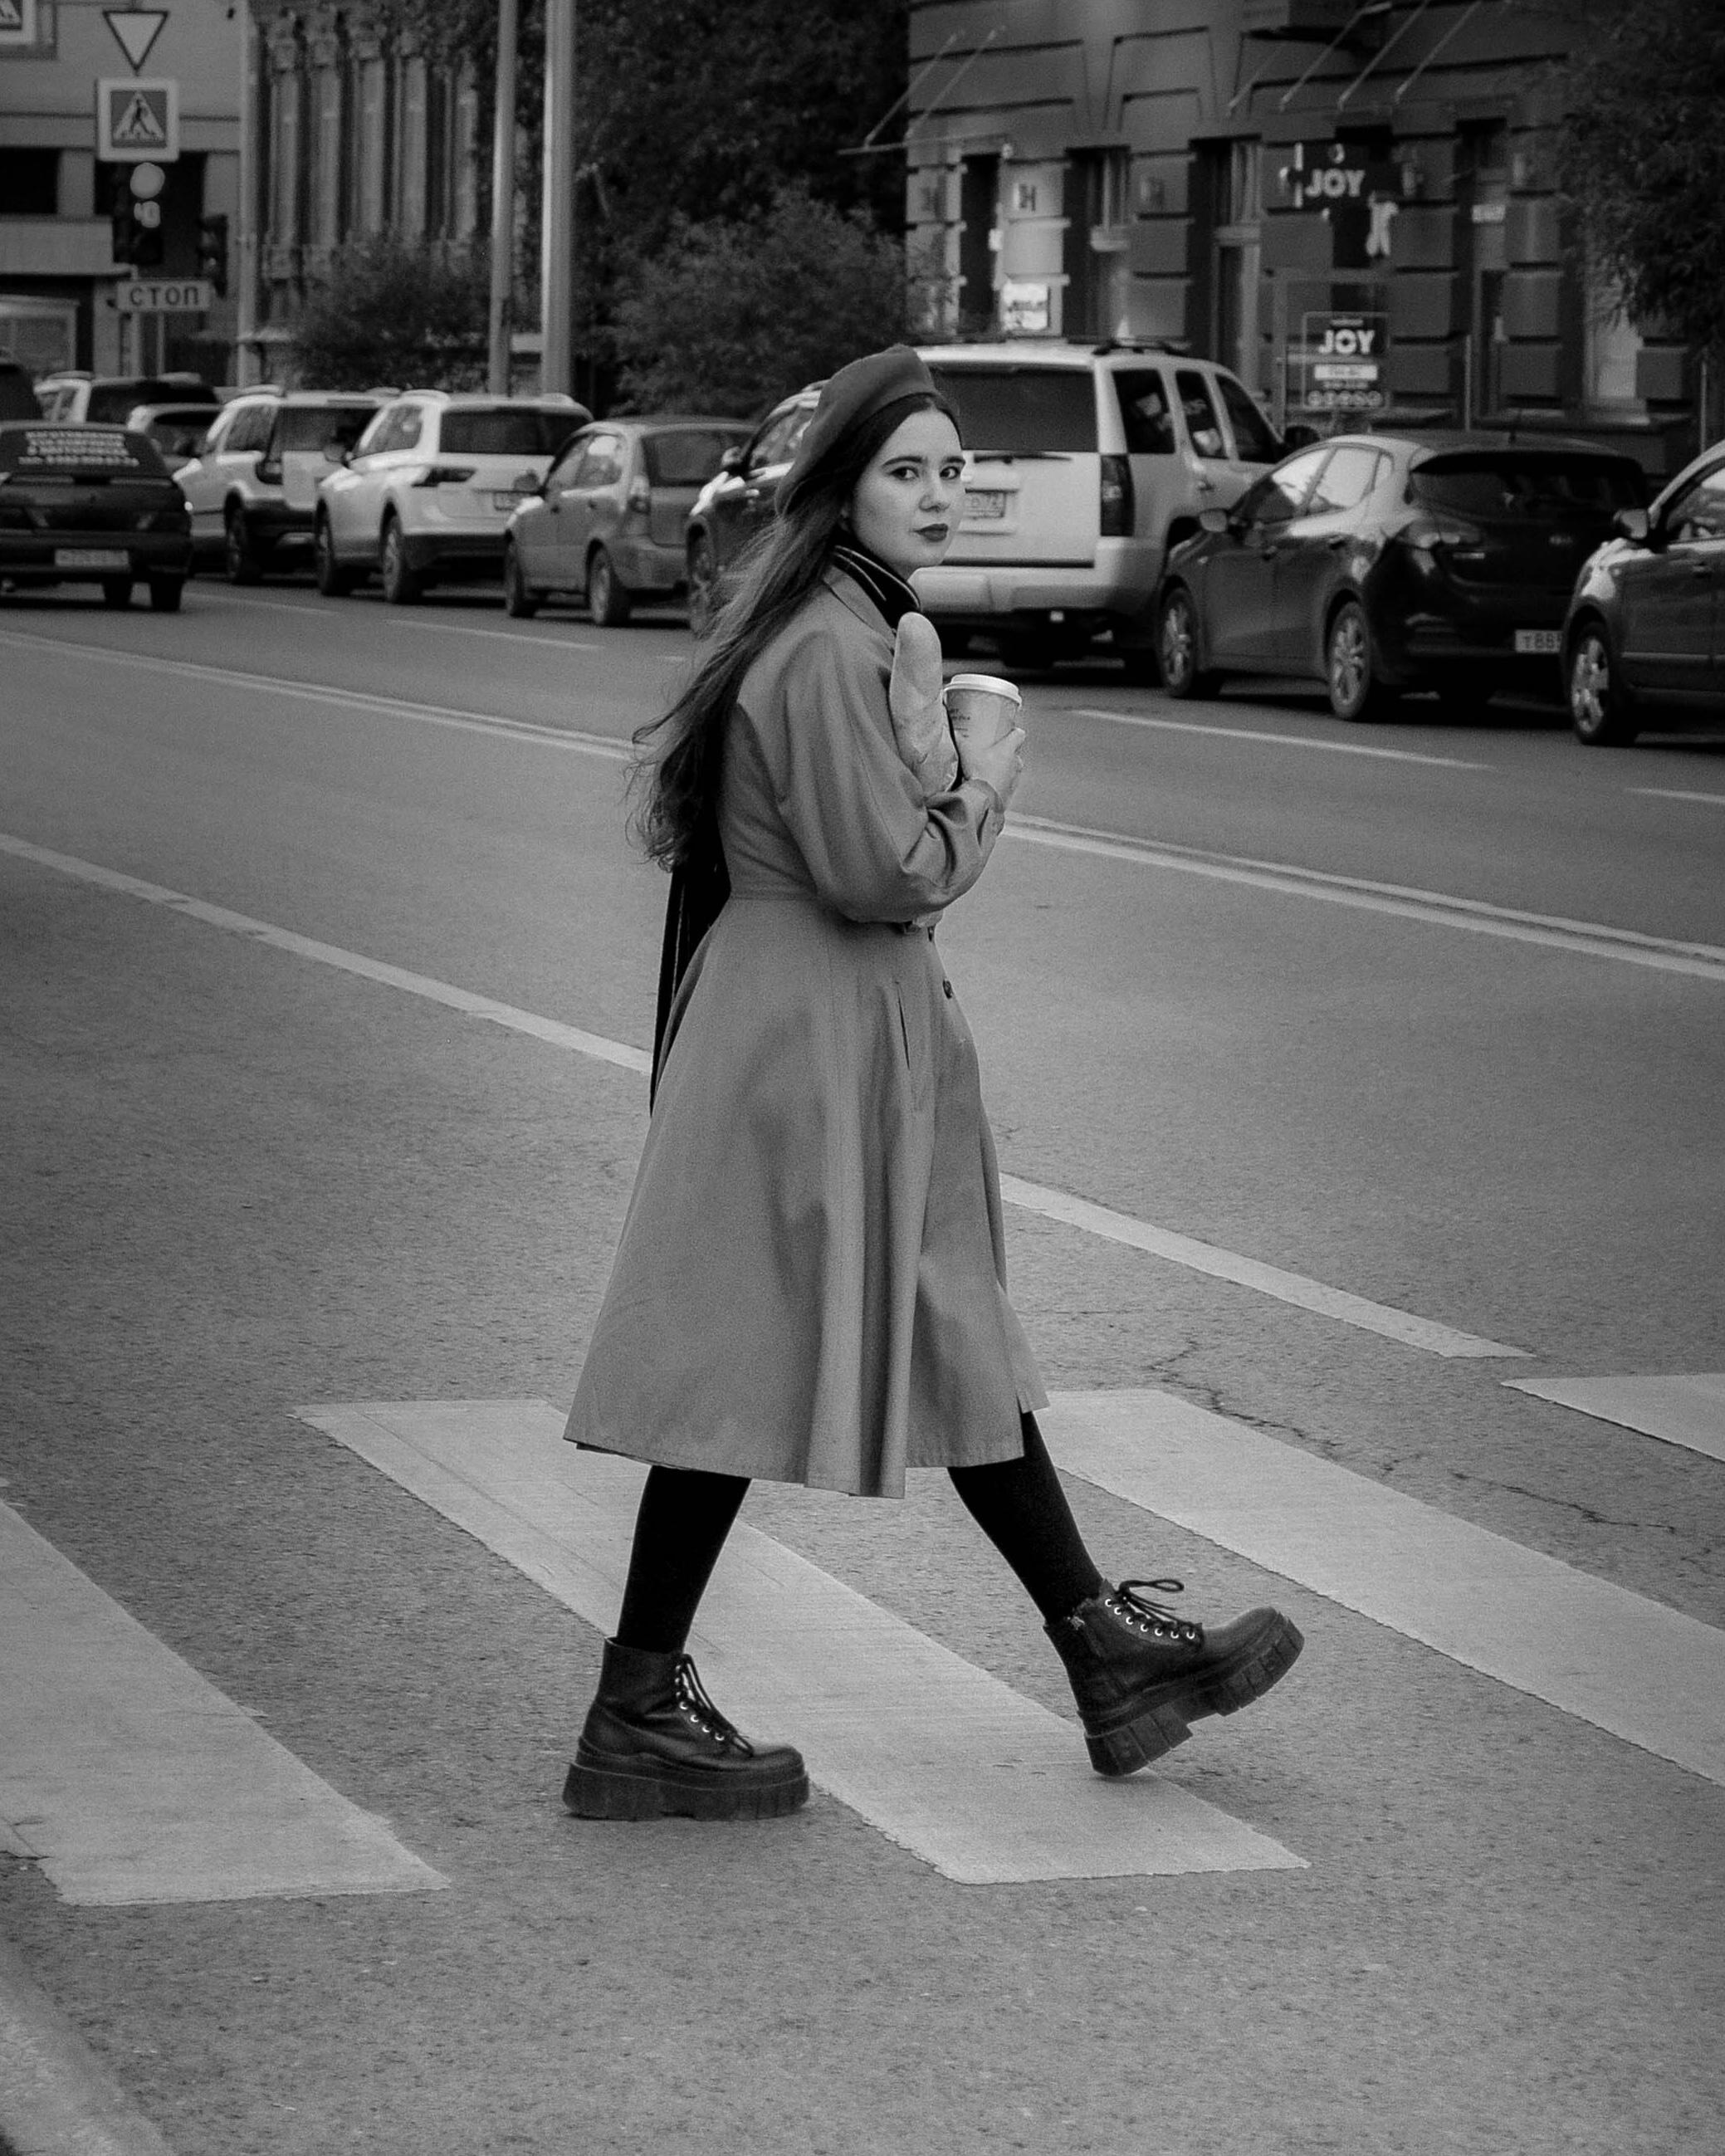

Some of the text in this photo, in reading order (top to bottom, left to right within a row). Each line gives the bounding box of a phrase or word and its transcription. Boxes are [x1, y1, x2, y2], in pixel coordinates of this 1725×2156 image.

[1305, 169, 1366, 198] JOY
[130, 286, 199, 306] СТОП
[1317, 329, 1376, 354] JOY
